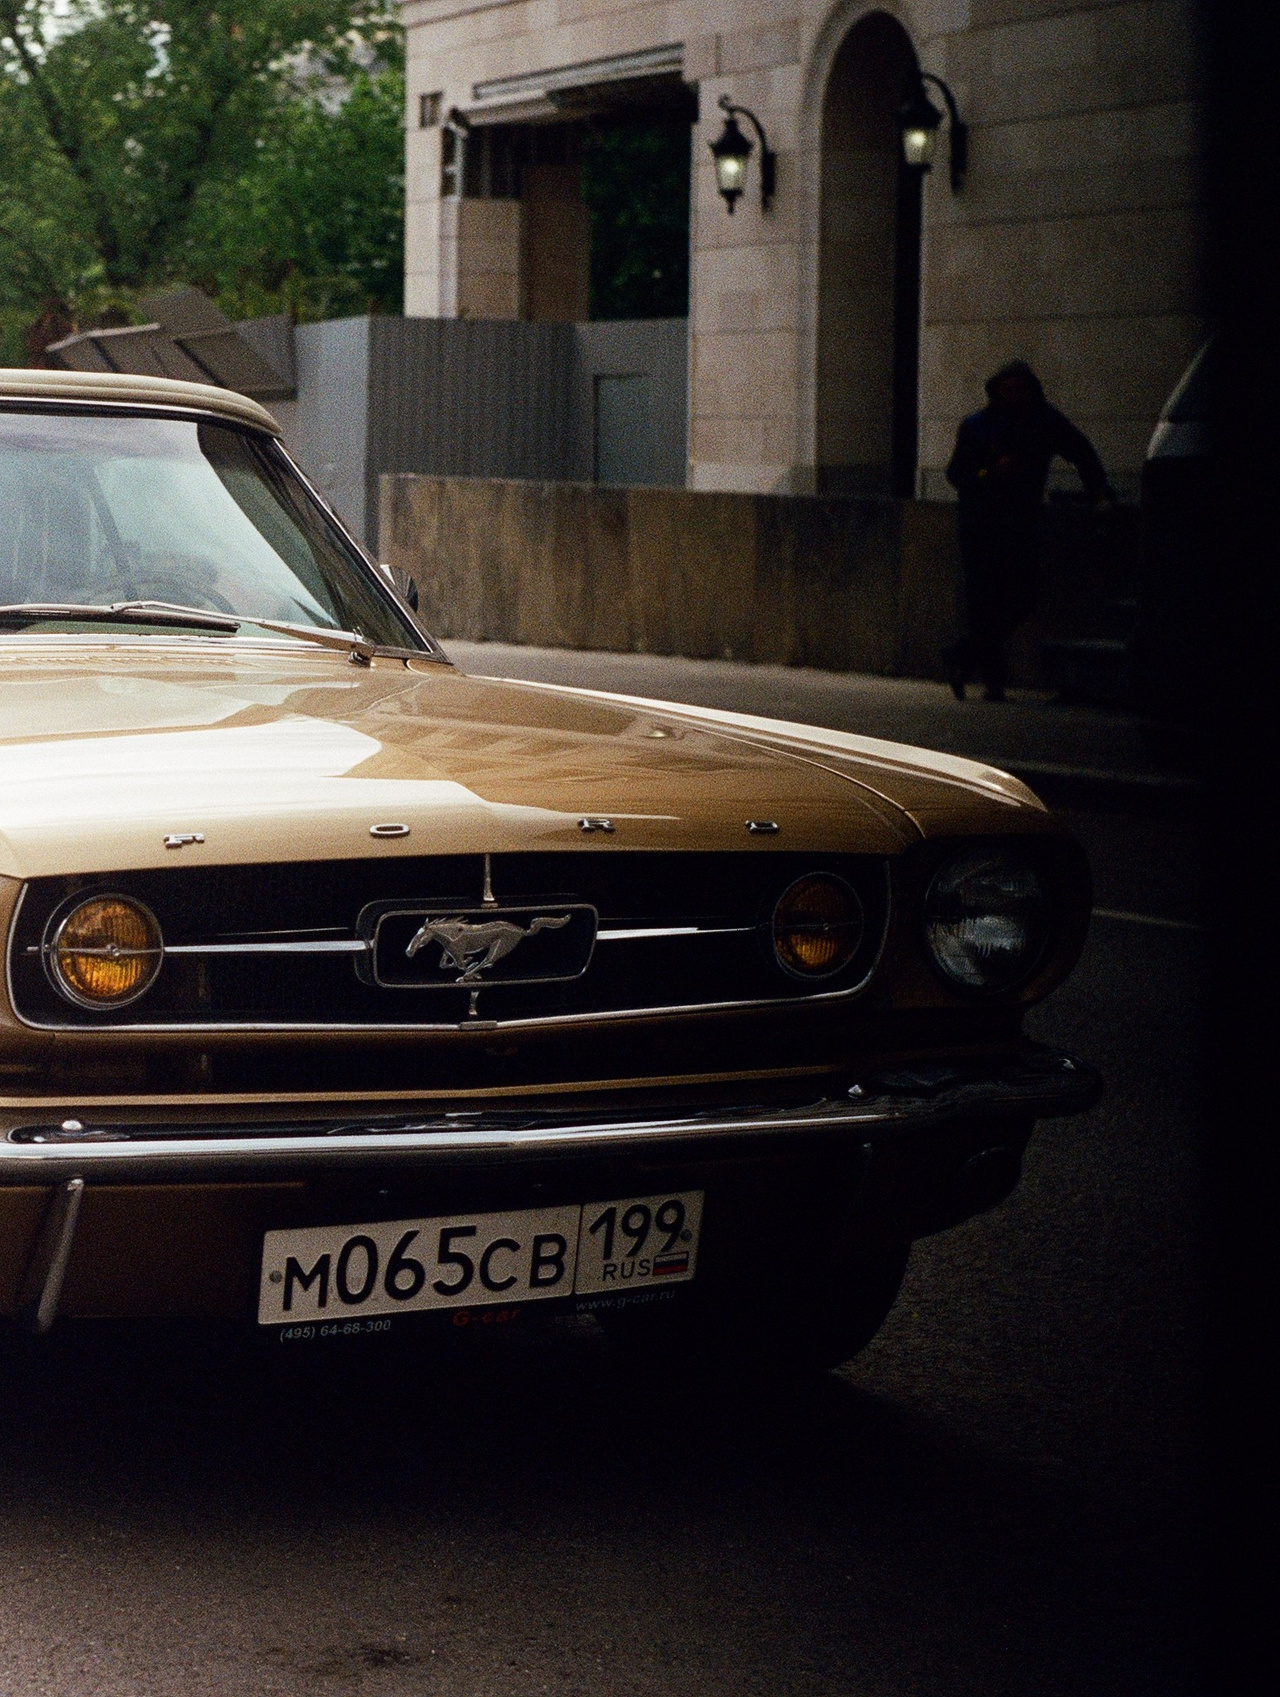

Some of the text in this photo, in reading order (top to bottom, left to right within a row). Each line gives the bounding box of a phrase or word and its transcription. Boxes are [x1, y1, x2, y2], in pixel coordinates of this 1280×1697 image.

[589, 1200, 686, 1260] 199
[602, 1260, 651, 1281] RUS
[576, 1291, 675, 1310] www.g-car.ru
[280, 1320, 392, 1342] (495) 64-68-300
